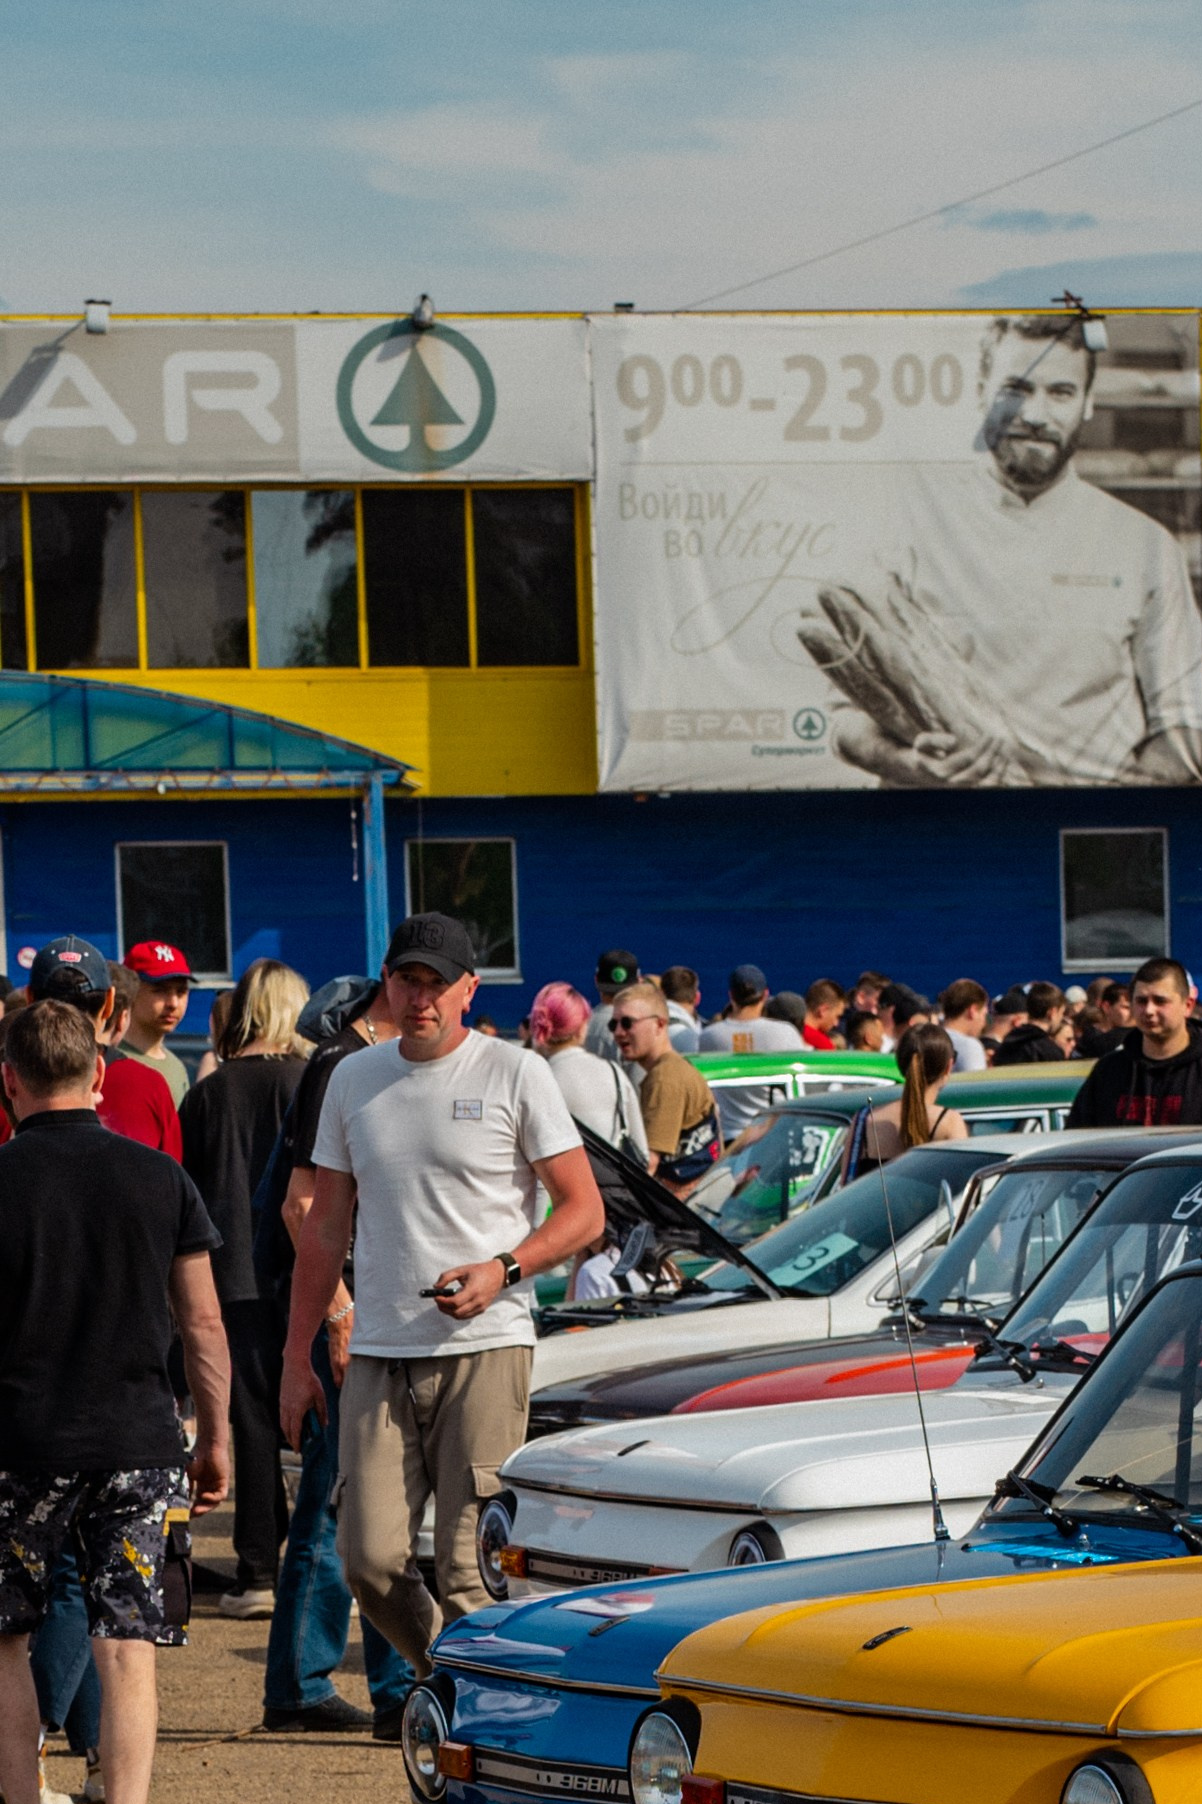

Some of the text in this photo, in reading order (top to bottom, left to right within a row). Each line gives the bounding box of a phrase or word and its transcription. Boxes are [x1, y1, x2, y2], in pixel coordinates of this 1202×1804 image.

[617, 480, 728, 527] Войди
[664, 529, 704, 559] во
[663, 713, 784, 737] SPAR
